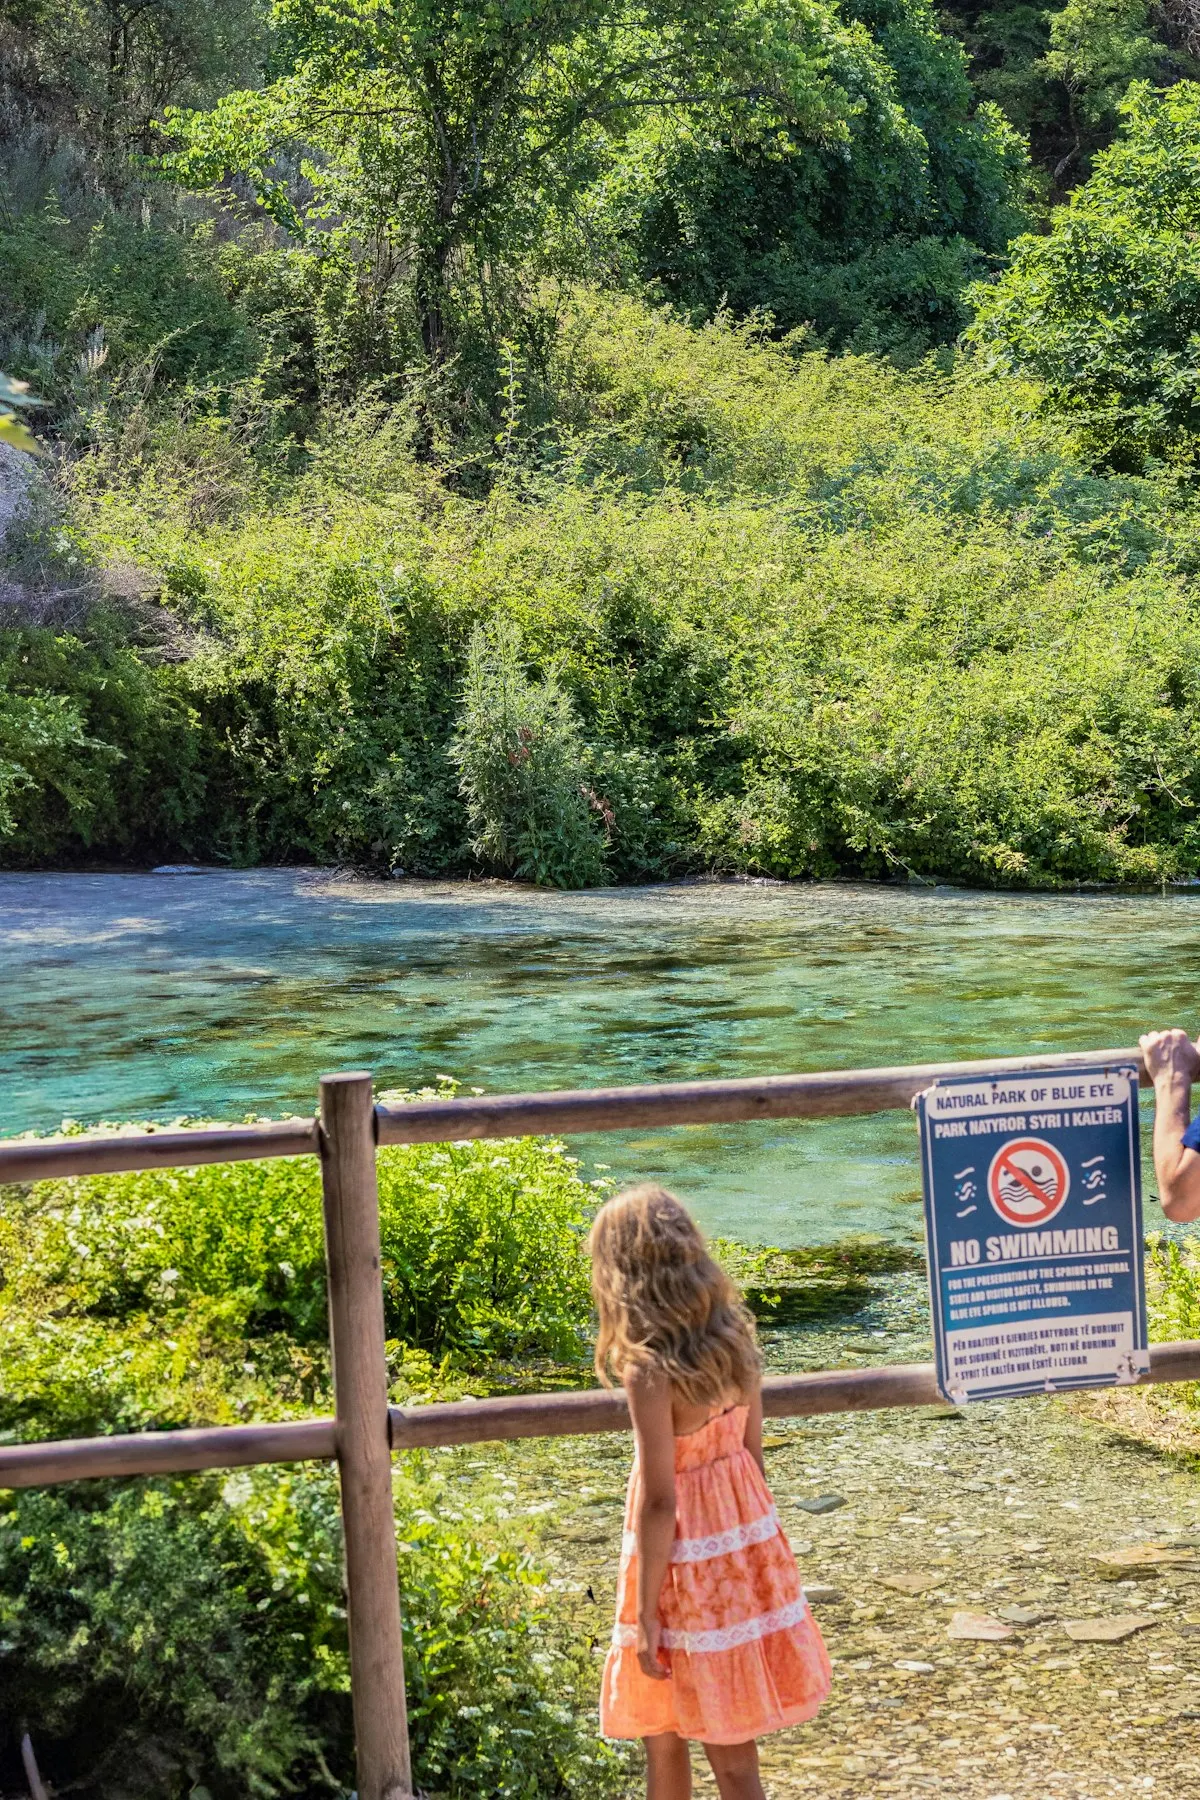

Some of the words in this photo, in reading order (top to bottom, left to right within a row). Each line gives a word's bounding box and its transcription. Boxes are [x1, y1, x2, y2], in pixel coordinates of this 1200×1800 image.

[936, 1093, 988, 1110] NATURAL
[992, 1090, 1026, 1105] PARK
[1031, 1089, 1047, 1102] OF
[1052, 1086, 1085, 1100] BLUE
[1090, 1084, 1114, 1097] EYE
[935, 1122, 967, 1138] PARK
[969, 1116, 1026, 1136] NATYROR
[1029, 1113, 1061, 1130] SYRI
[1072, 1107, 1122, 1127] KALTËR
[950, 1238, 980, 1266] NO
[986, 1226, 1119, 1261] SWIMMING
[948, 1279, 963, 1291] FOR
[962, 1277, 976, 1289] THE
[1028, 1268, 1038, 1280] OF
[1039, 1268, 1054, 1279] THE
[1093, 1261, 1130, 1275] NATURAL
[949, 1293, 970, 1306] STATE
[970, 1291, 985, 1302] AND
[985, 1287, 1014, 1300] VISITOR
[1043, 1280, 1087, 1294] SWIMMING
[1086, 1279, 1097, 1290] IN
[1097, 1277, 1113, 1289] THE
[950, 1308, 968, 1321] BLUE
[968, 1306, 982, 1318] EYE
[982, 1302, 1009, 1316] SPRING
[1008, 1301, 1017, 1312] IS
[1017, 1299, 1031, 1311] NOT
[1031, 1296, 1071, 1310] ALLOWED.
[953, 1339, 966, 1351] PËR
[1039, 1327, 1079, 1339] NATYRORE
[1080, 1323, 1090, 1336] TË
[1091, 1323, 1125, 1335] BURIMIT
[954, 1355, 967, 1366] DHE
[1050, 1342, 1069, 1353] NOTI
[1070, 1339, 1080, 1351] NË
[1082, 1338, 1117, 1350] BURIMIN
[960, 1368, 980, 1381] SYRIT
[981, 1365, 990, 1378] TË
[990, 1363, 1016, 1376] KALTËR
[1016, 1361, 1031, 1373] NUK
[1032, 1356, 1053, 1370] ËSHTË
[1059, 1355, 1088, 1368] LEJUAR
